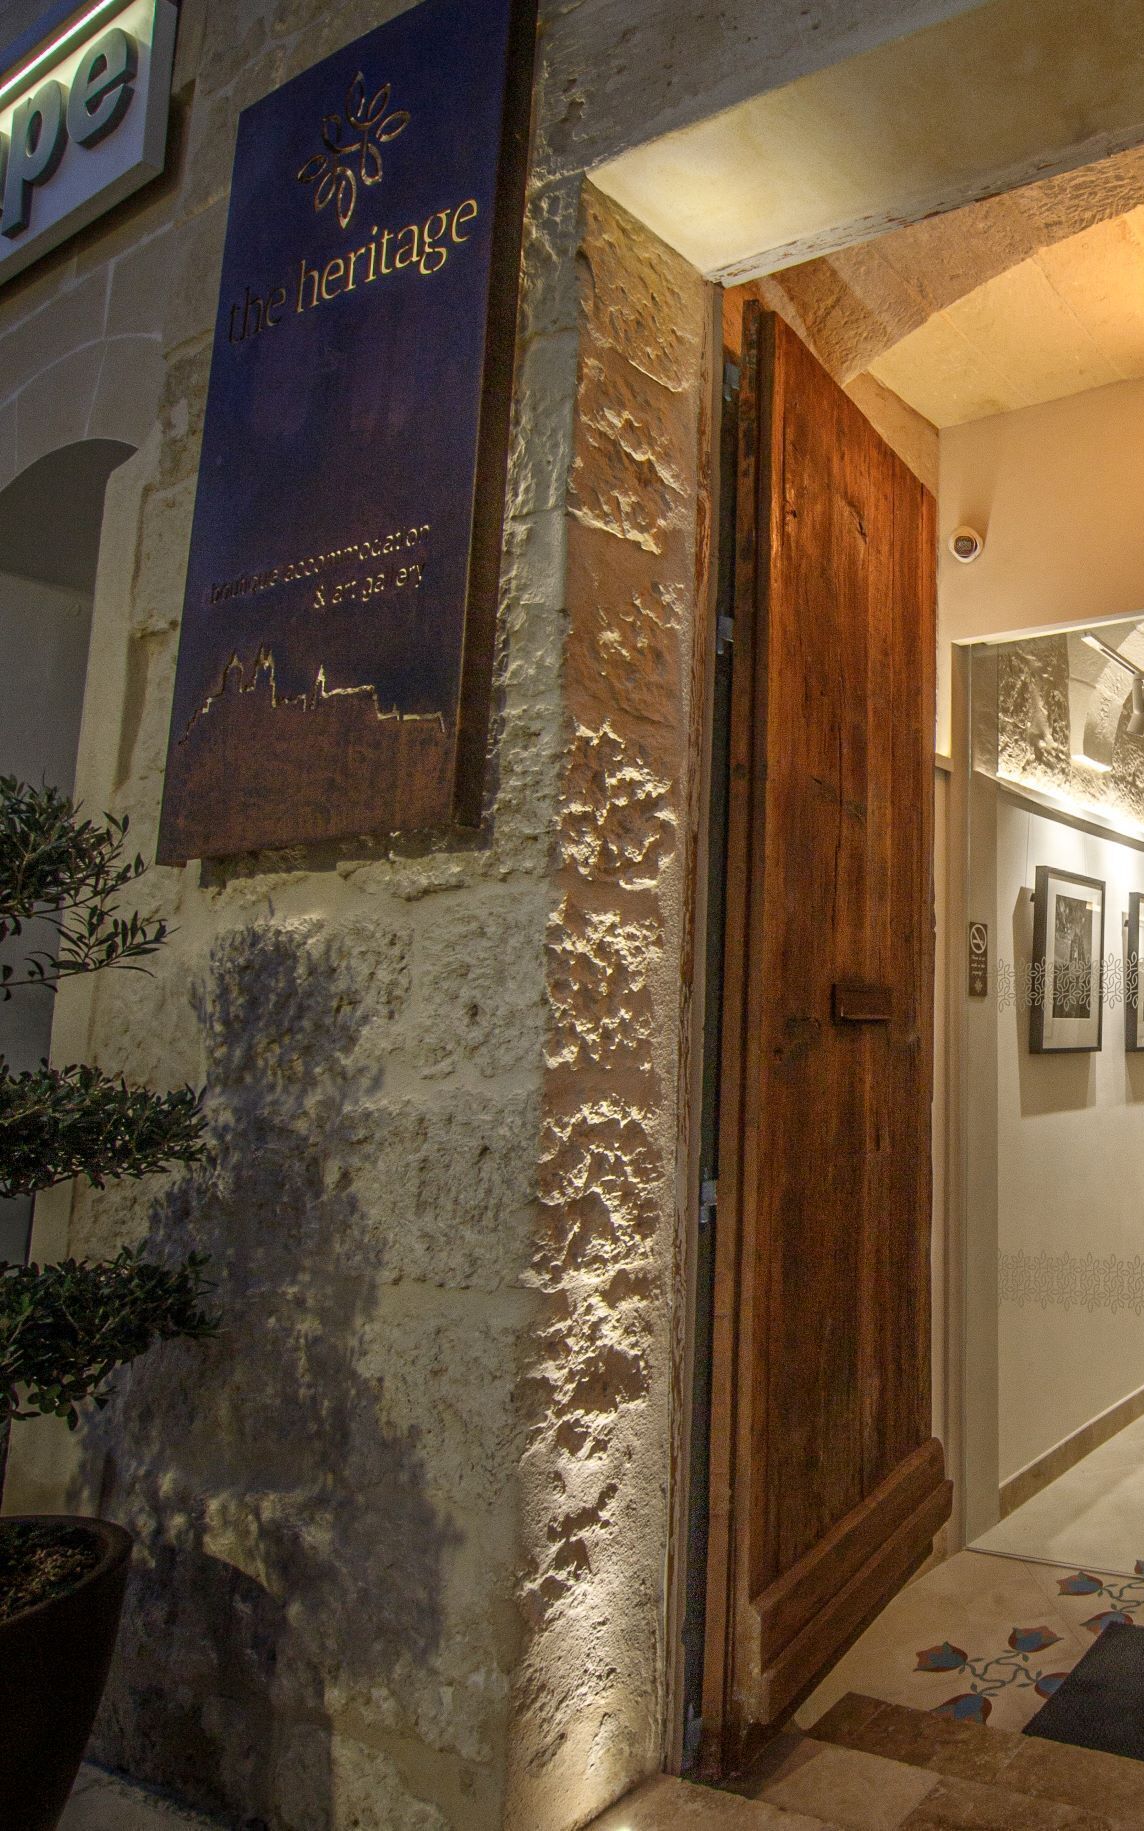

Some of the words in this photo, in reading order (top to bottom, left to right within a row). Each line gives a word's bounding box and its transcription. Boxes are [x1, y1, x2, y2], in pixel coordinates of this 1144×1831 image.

[0, 28, 137, 239] pe
[228, 287, 286, 344] the
[296, 199, 478, 313] heritage
[332, 580, 357, 604] art
